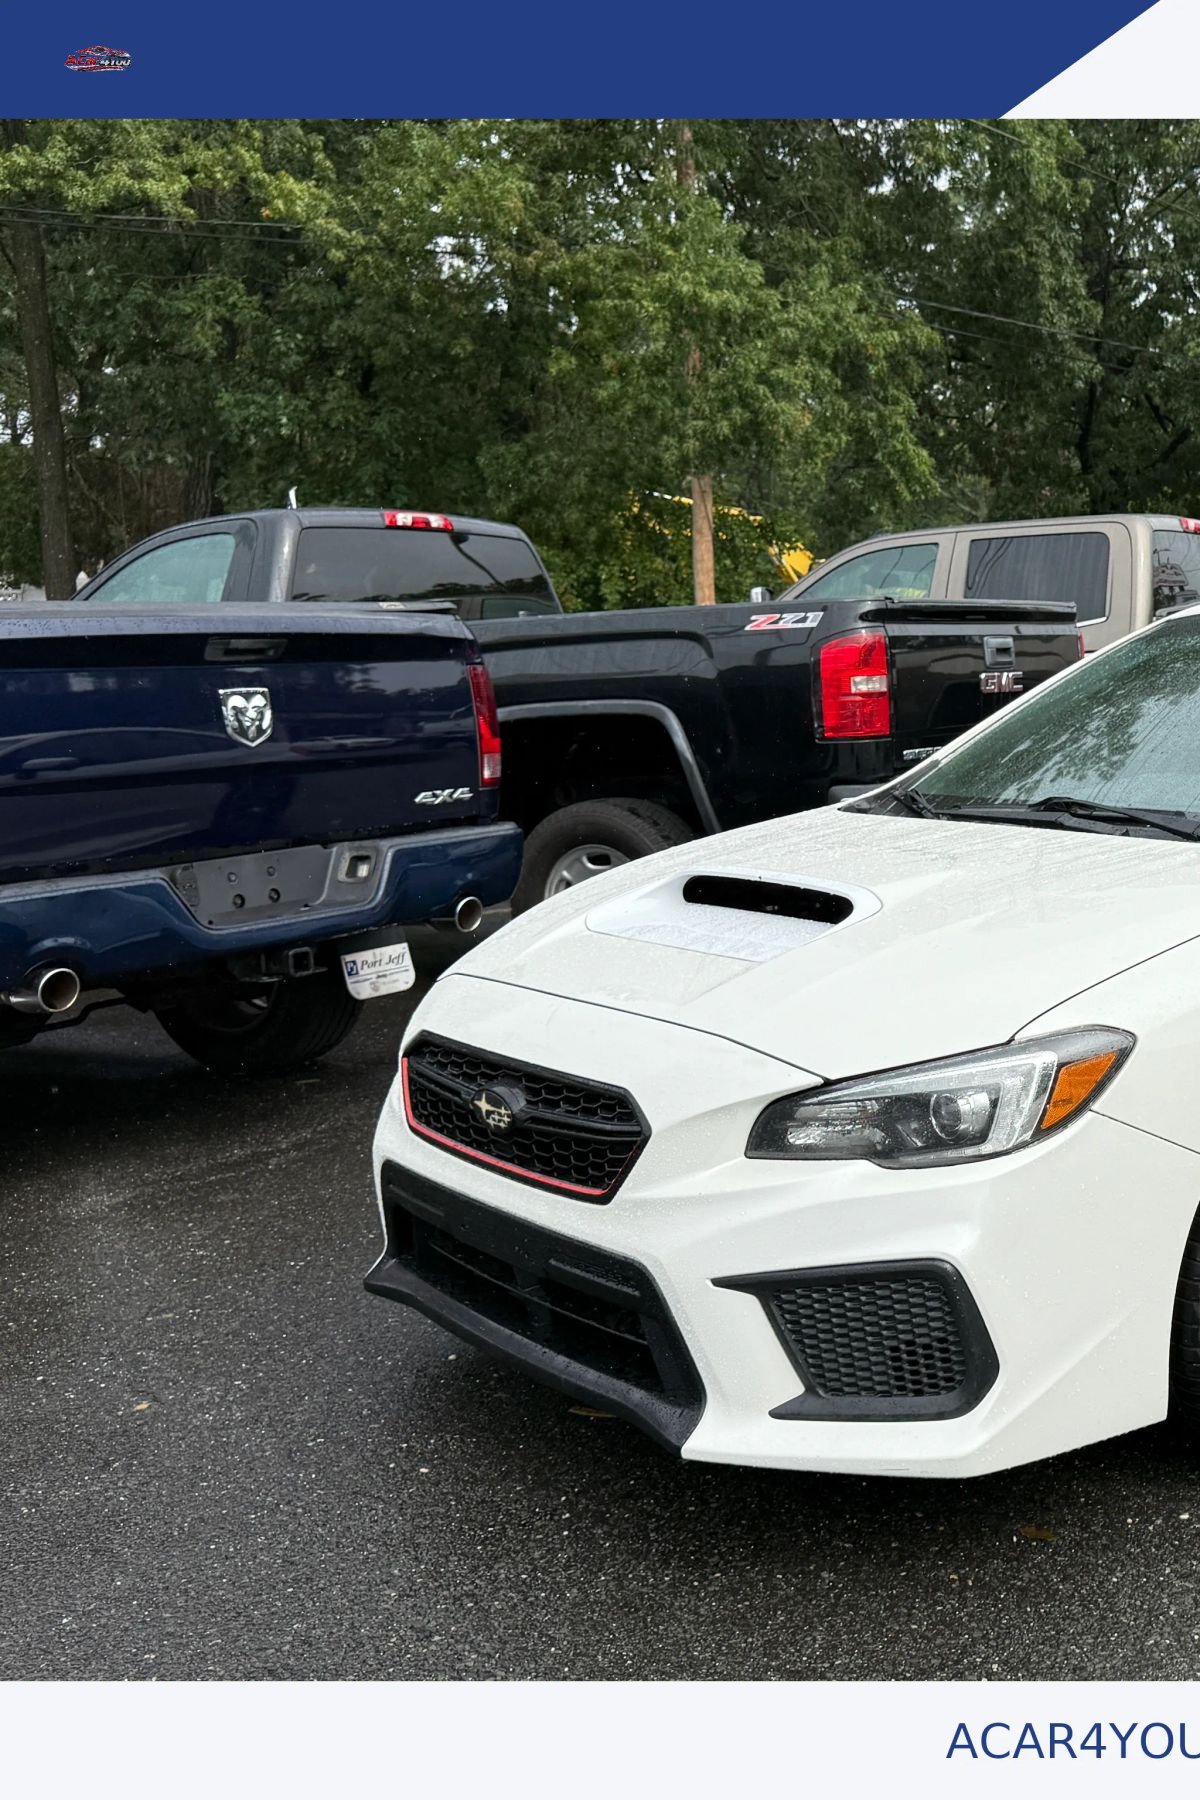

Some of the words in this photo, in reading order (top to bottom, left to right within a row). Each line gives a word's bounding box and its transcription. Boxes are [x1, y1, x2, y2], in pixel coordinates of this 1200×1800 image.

[744, 611, 824, 631] Z71
[979, 671, 1023, 693] GMC
[360, 958, 382, 971] Port
[385, 951, 407, 966] Jeff
